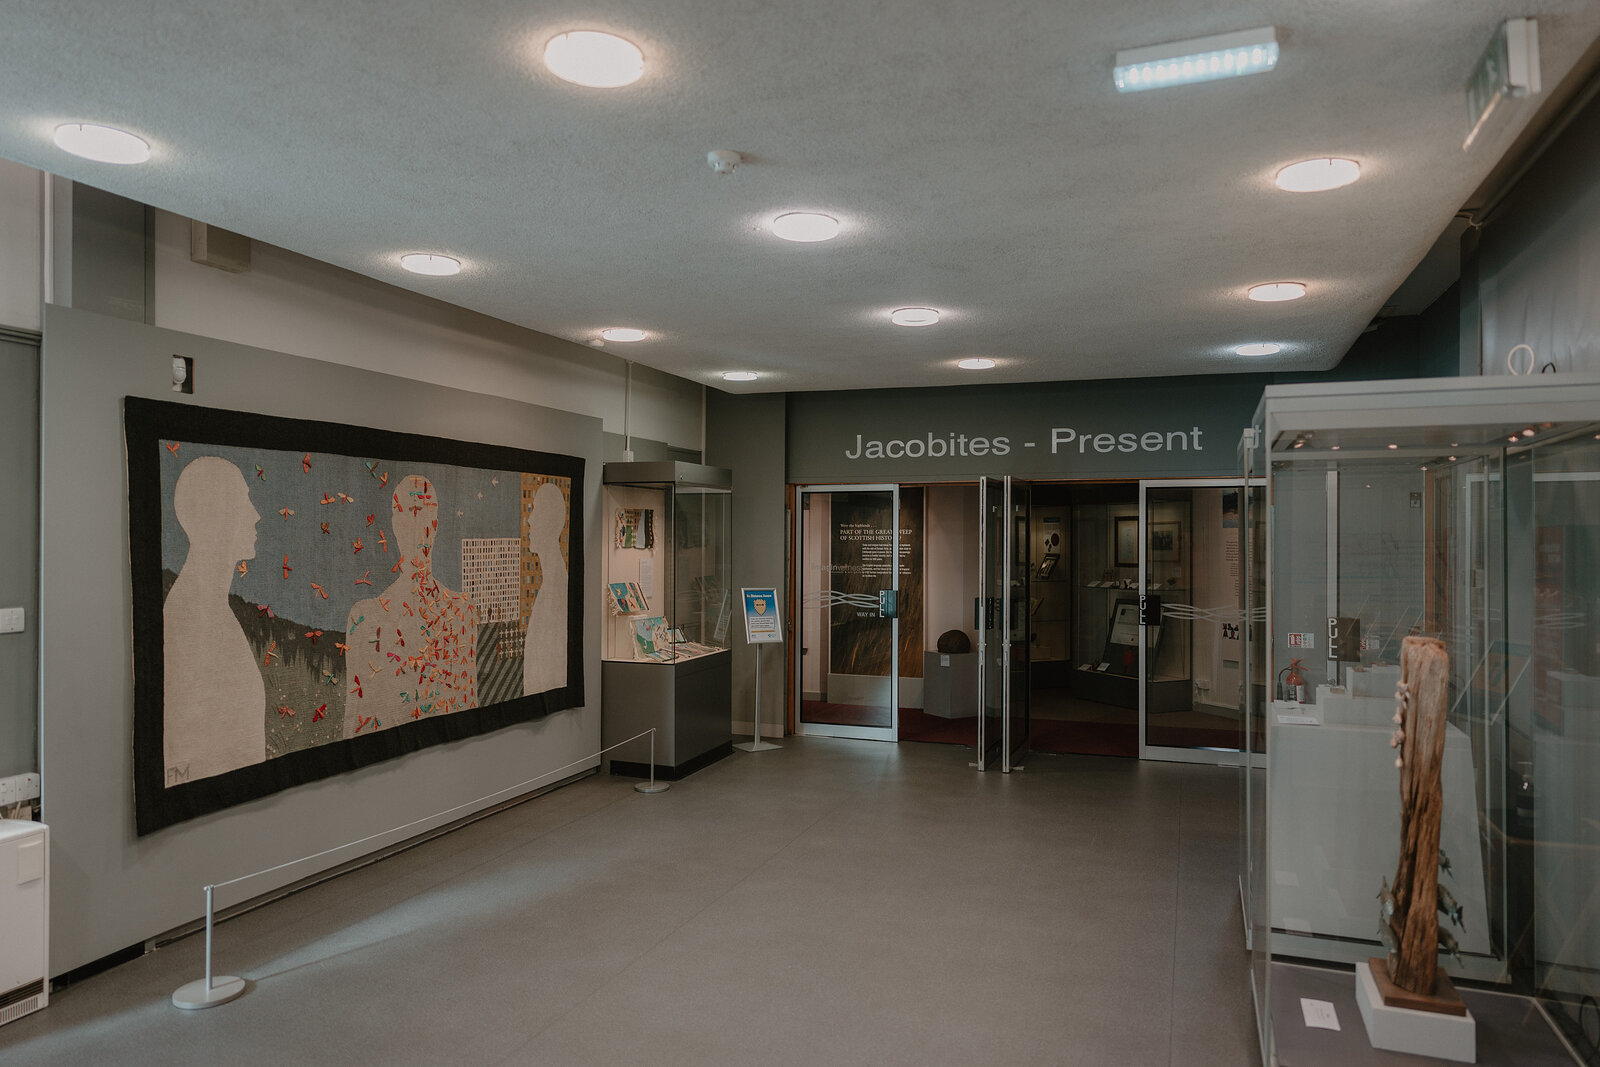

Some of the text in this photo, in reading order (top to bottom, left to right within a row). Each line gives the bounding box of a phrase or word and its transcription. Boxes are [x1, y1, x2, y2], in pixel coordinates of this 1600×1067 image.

[846, 432, 1011, 459] Jacobites
[1051, 426, 1203, 454] Present
[1328, 618, 1338, 658] PULL
